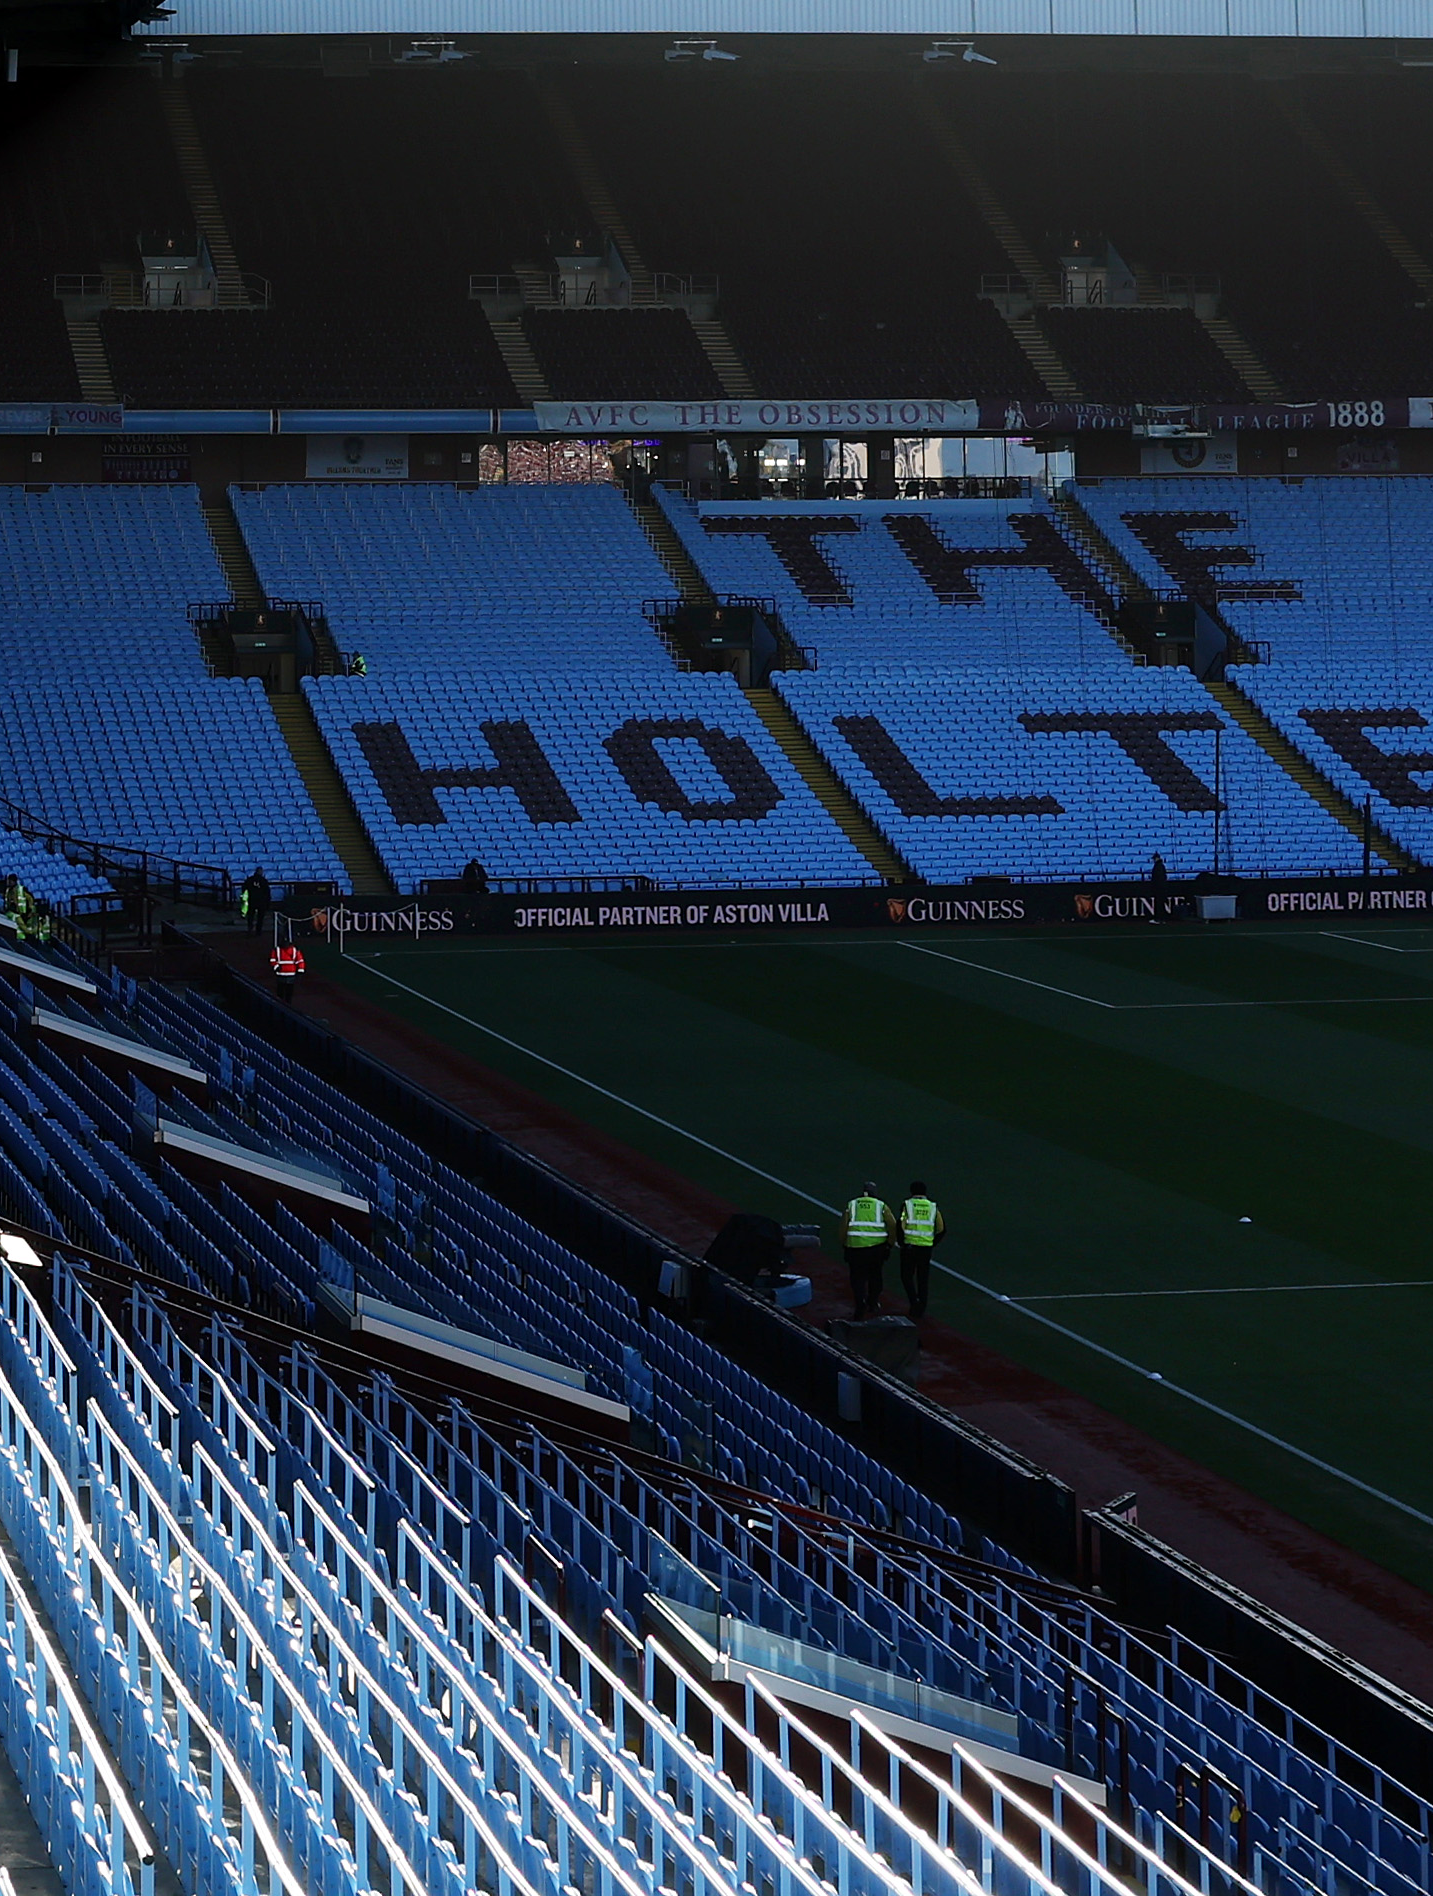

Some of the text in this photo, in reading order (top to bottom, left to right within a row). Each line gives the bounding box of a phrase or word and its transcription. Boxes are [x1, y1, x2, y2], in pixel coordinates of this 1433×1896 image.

[66, 409, 123, 424] YOUNG
[564, 403, 946, 428] AVFC THE OBSESSION
[1217, 413, 1315, 429] LEAGUE
[1327, 400, 1386, 428] 1888
[119, 444, 154, 454] EVERY
[156, 443, 189, 454] SENSE
[701, 511, 1302, 612] THE
[907, 898, 1026, 923] GUINNESS
[1267, 891, 1344, 912] OFFICIAL
[331, 908, 454, 933] GUINNESS
[514, 903, 830, 928] OFFICIAL PARTNER OF ASTON VILLA
